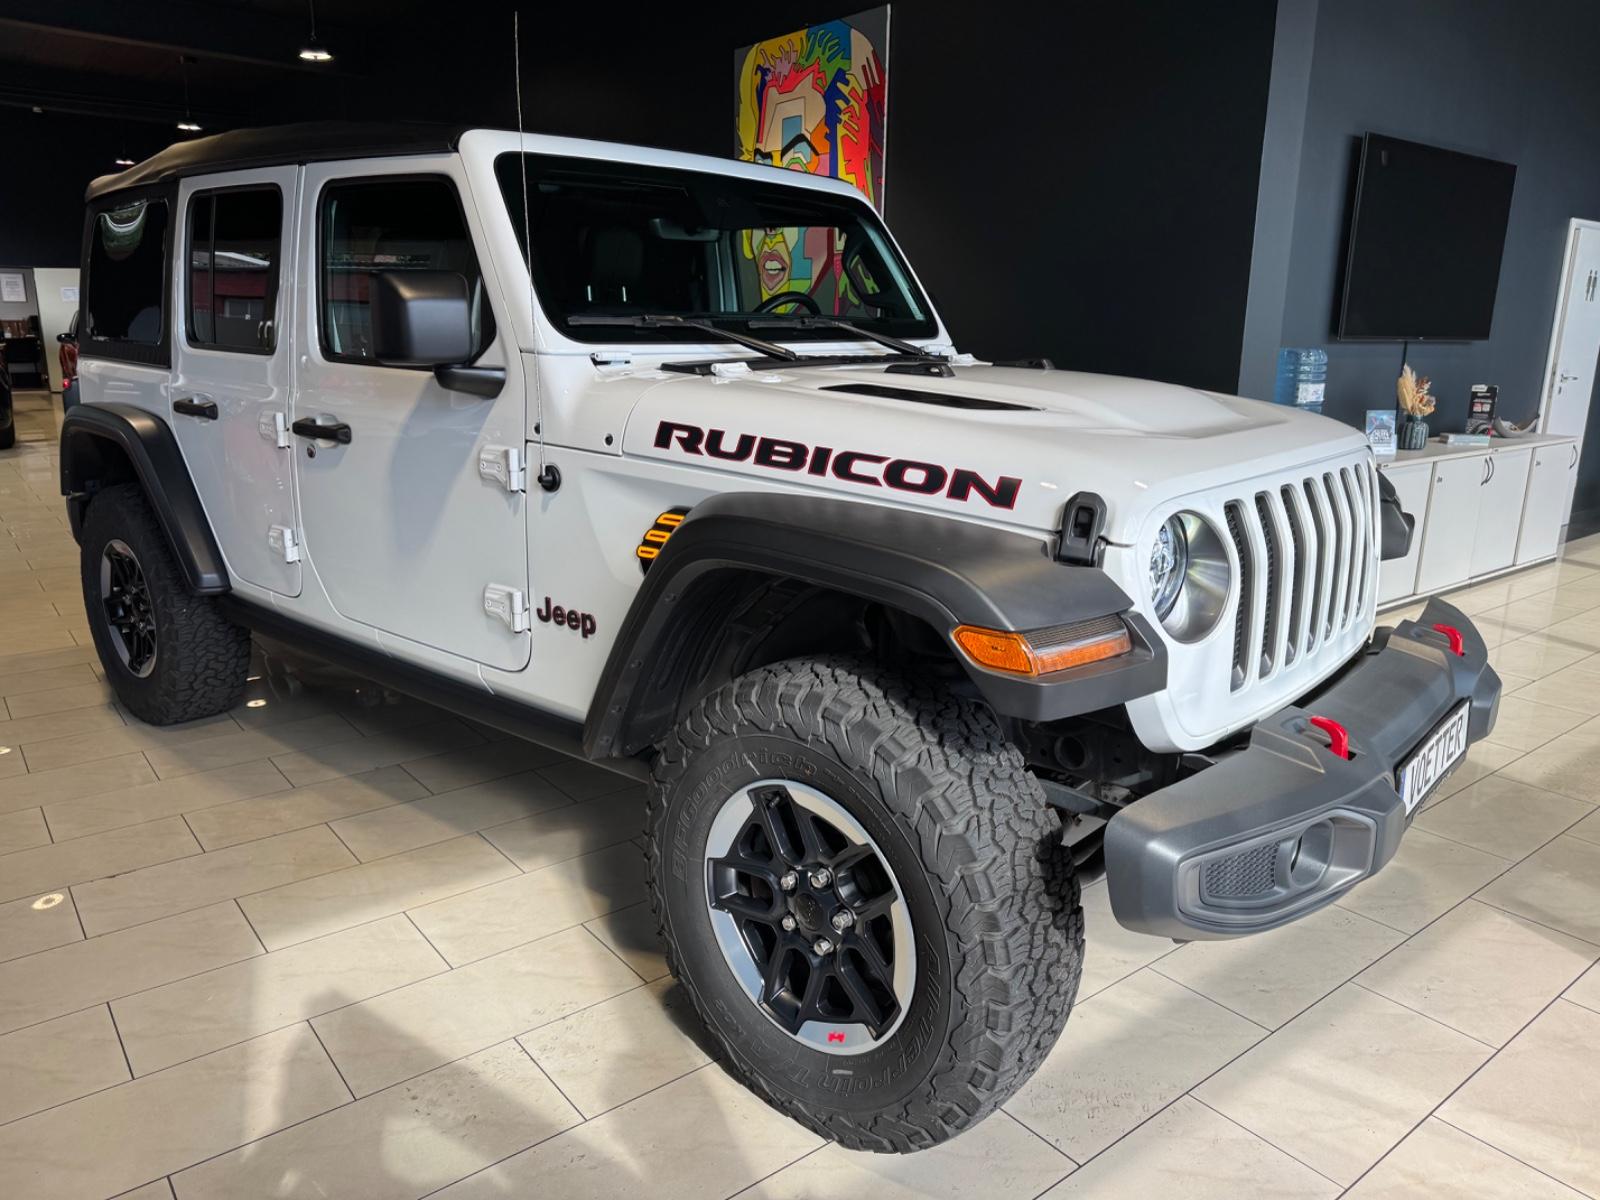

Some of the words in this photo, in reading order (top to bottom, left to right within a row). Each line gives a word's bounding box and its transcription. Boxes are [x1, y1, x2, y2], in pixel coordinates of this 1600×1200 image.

[653, 420, 1023, 510] RUBICON
[536, 596, 597, 639] Jeep
[1409, 713, 1464, 805] VOETTER
[671, 747, 818, 882] BFGoodrich
